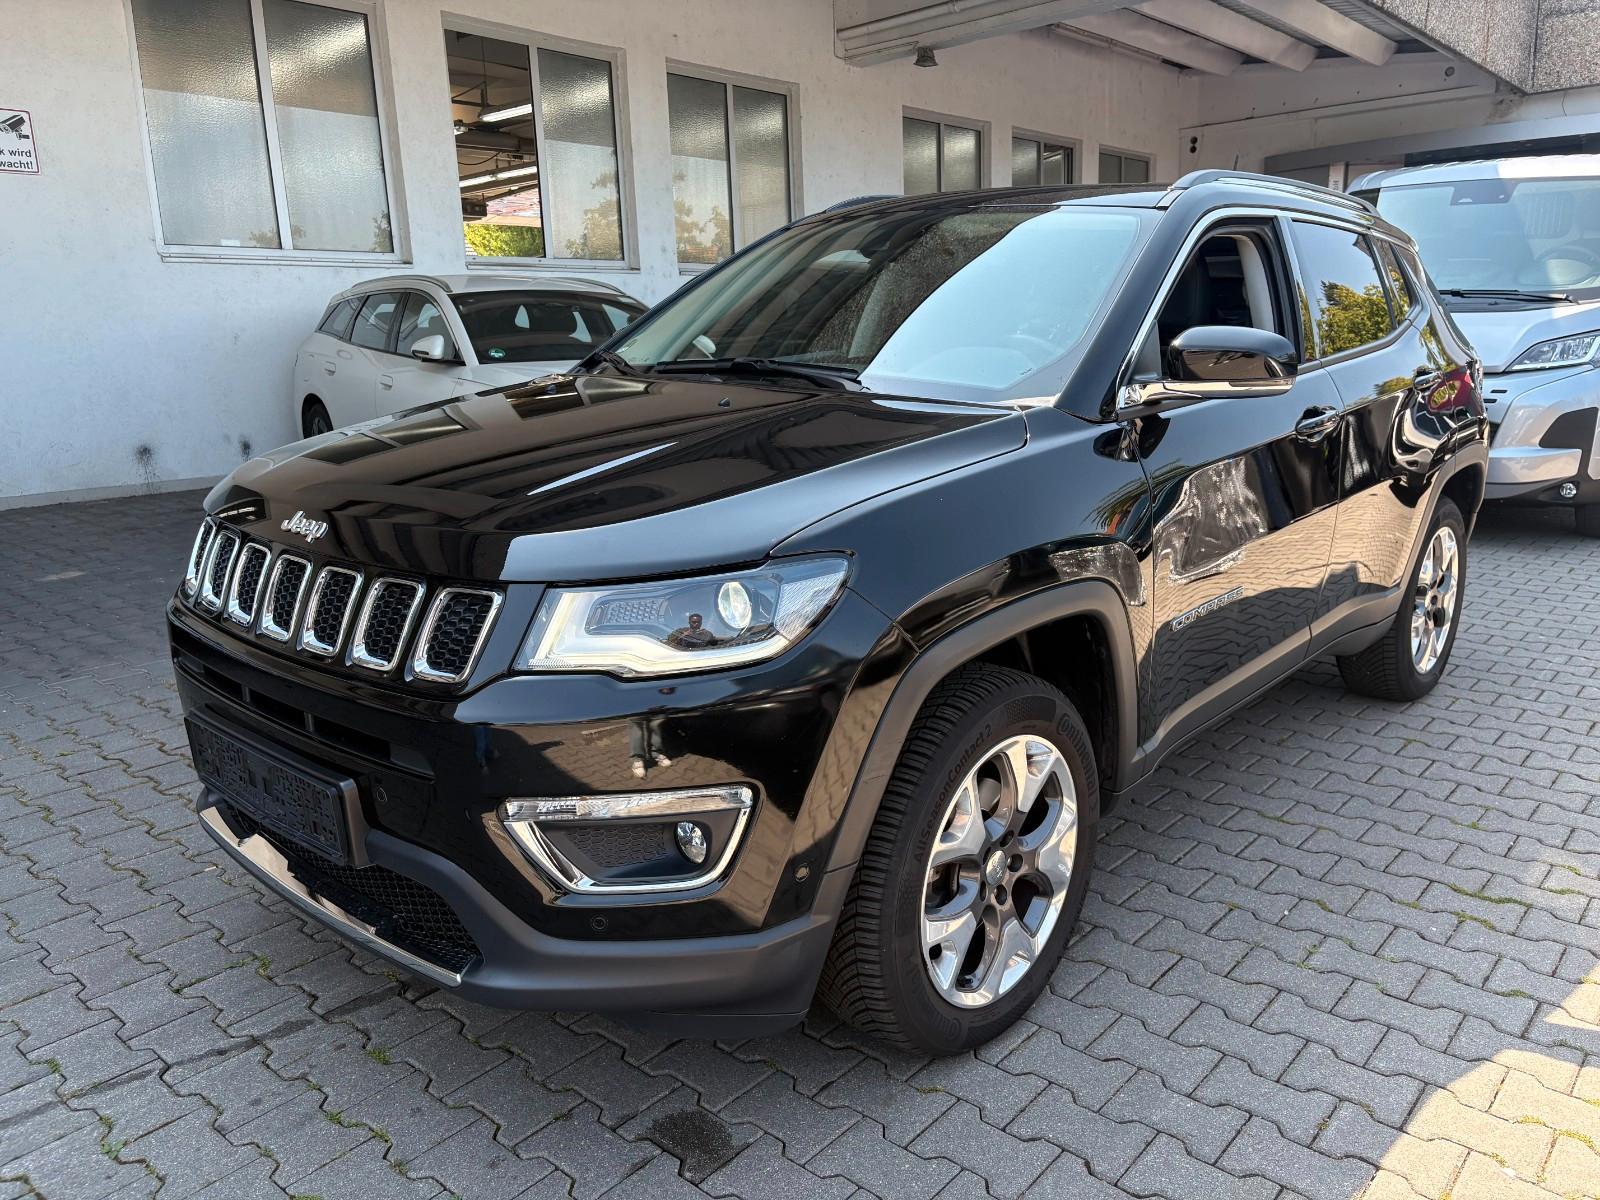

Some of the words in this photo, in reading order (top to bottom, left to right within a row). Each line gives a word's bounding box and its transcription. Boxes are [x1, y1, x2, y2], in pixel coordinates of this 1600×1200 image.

[8, 148, 32, 158] wird
[0, 160, 33, 170] wacht!
[281, 510, 328, 543] Jeep
[914, 733, 986, 864] AllSeasonContact
